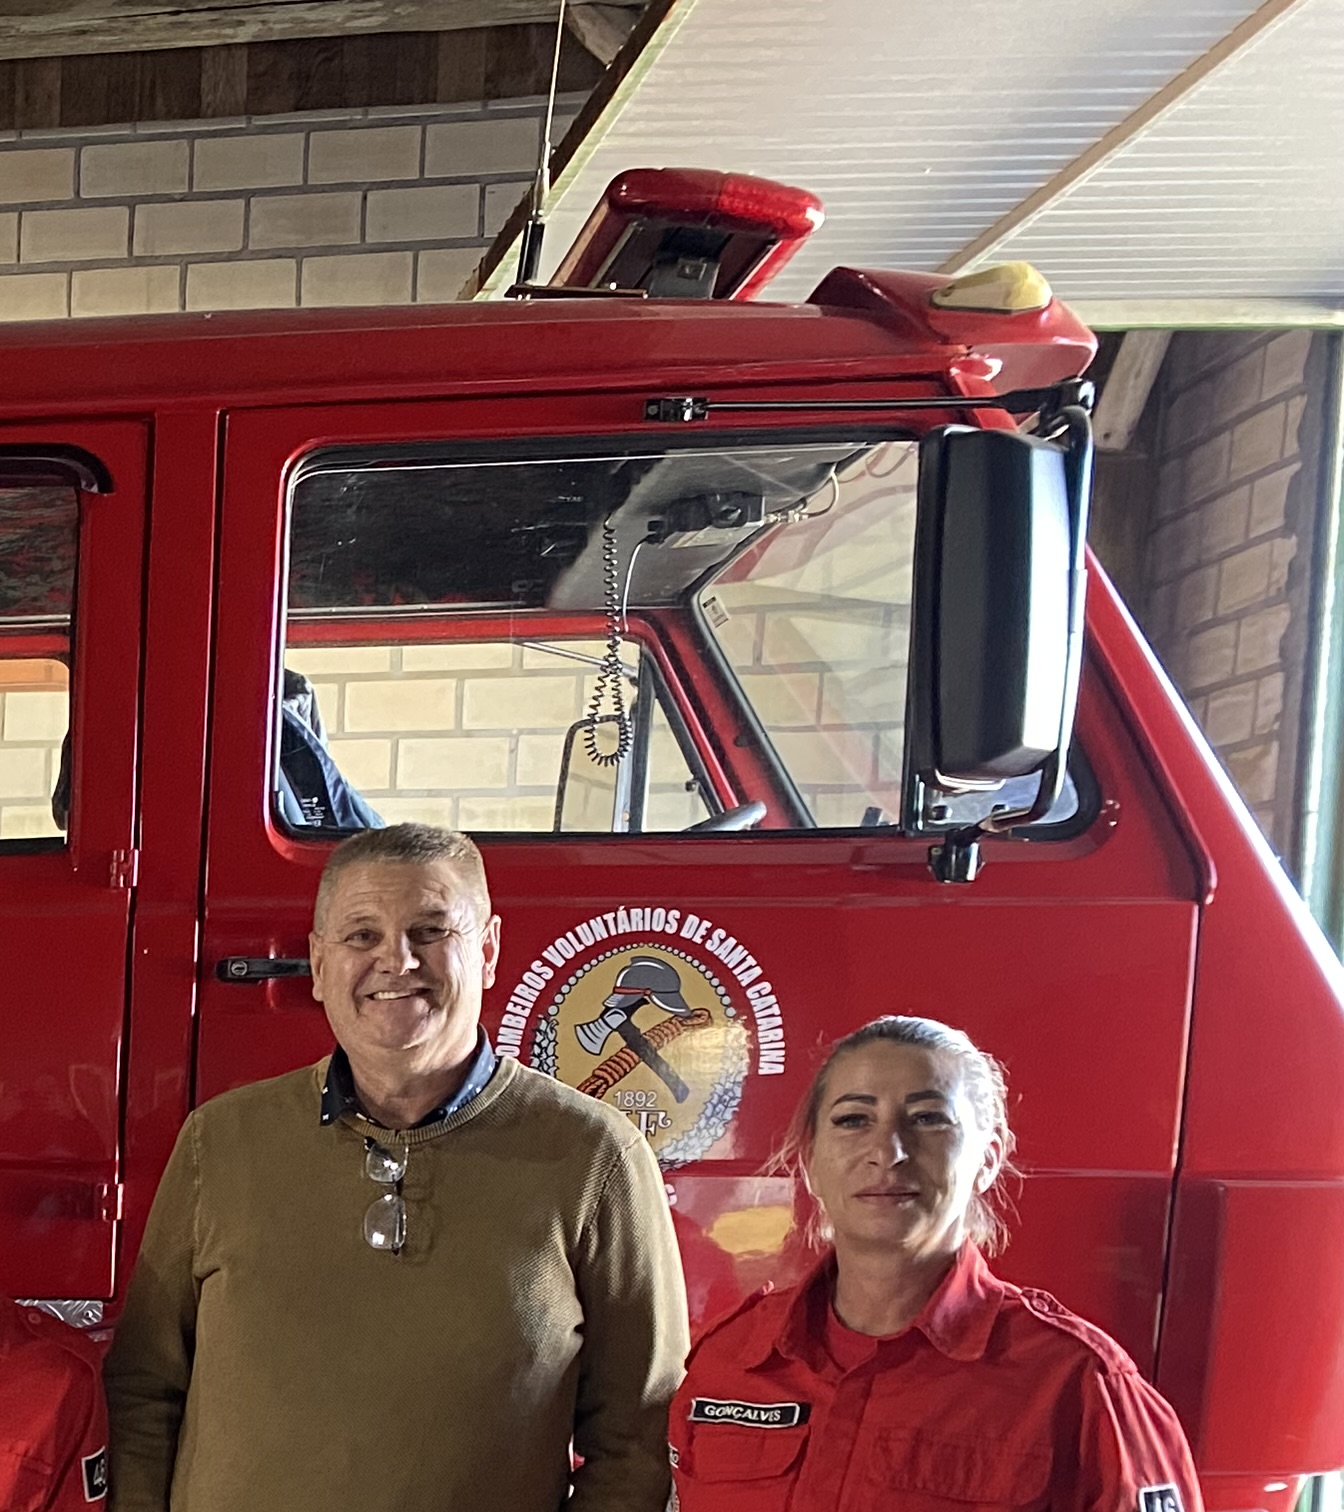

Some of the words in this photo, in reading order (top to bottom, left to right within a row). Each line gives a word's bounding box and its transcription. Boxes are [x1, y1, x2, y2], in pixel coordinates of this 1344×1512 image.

[494, 960, 554, 1057] OMBEIROS
[542, 906, 680, 968] VOLUNTÁRIOS
[680, 914, 712, 944] DE
[705, 928, 763, 987] SANTA
[745, 982, 786, 1075] CATARINA
[614, 1090, 658, 1107] 1892
[704, 1405, 781, 1422] GONÇALVES
